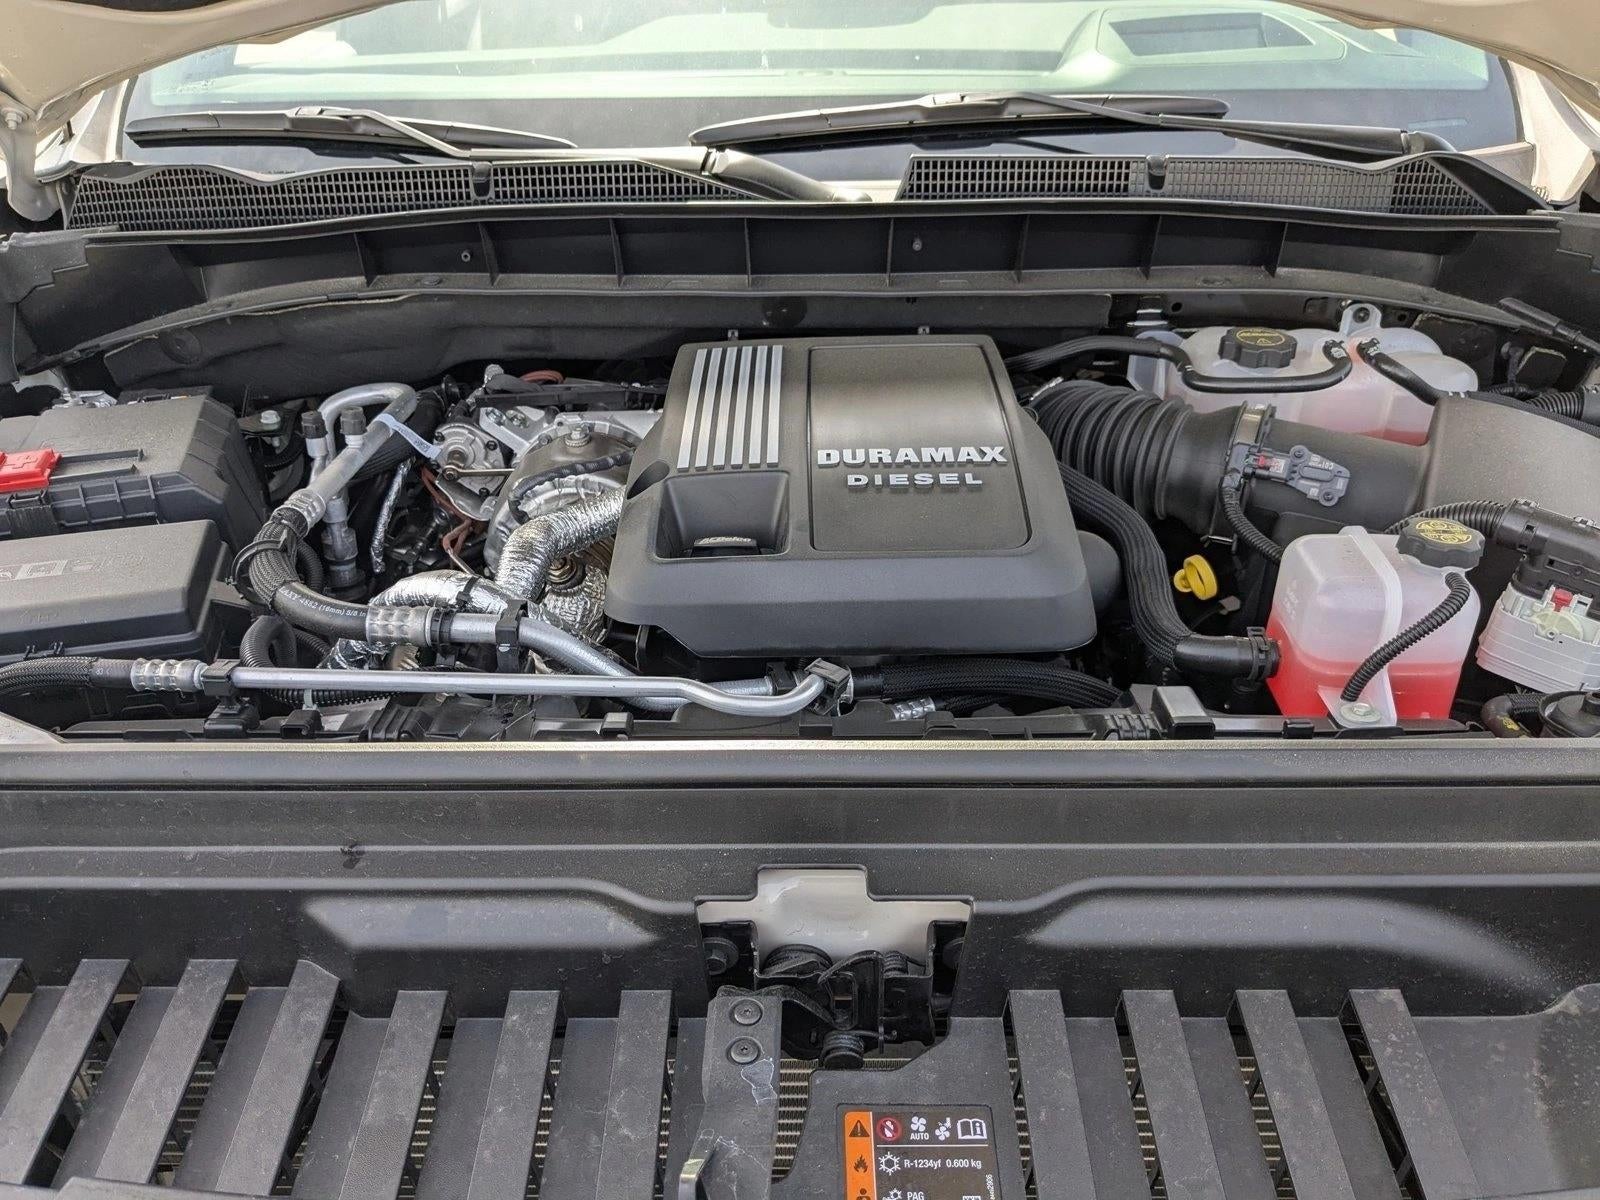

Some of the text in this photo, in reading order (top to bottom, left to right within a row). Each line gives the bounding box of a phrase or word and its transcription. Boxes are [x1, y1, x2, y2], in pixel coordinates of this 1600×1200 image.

[817, 446, 1008, 467] DURAMAX
[847, 473, 983, 487] DIESEL
[910, 1132, 930, 1140] AUTO
[904, 1158, 982, 1170] R-1234yf 0.600 kg
[906, 1191, 925, 1200] PAG
